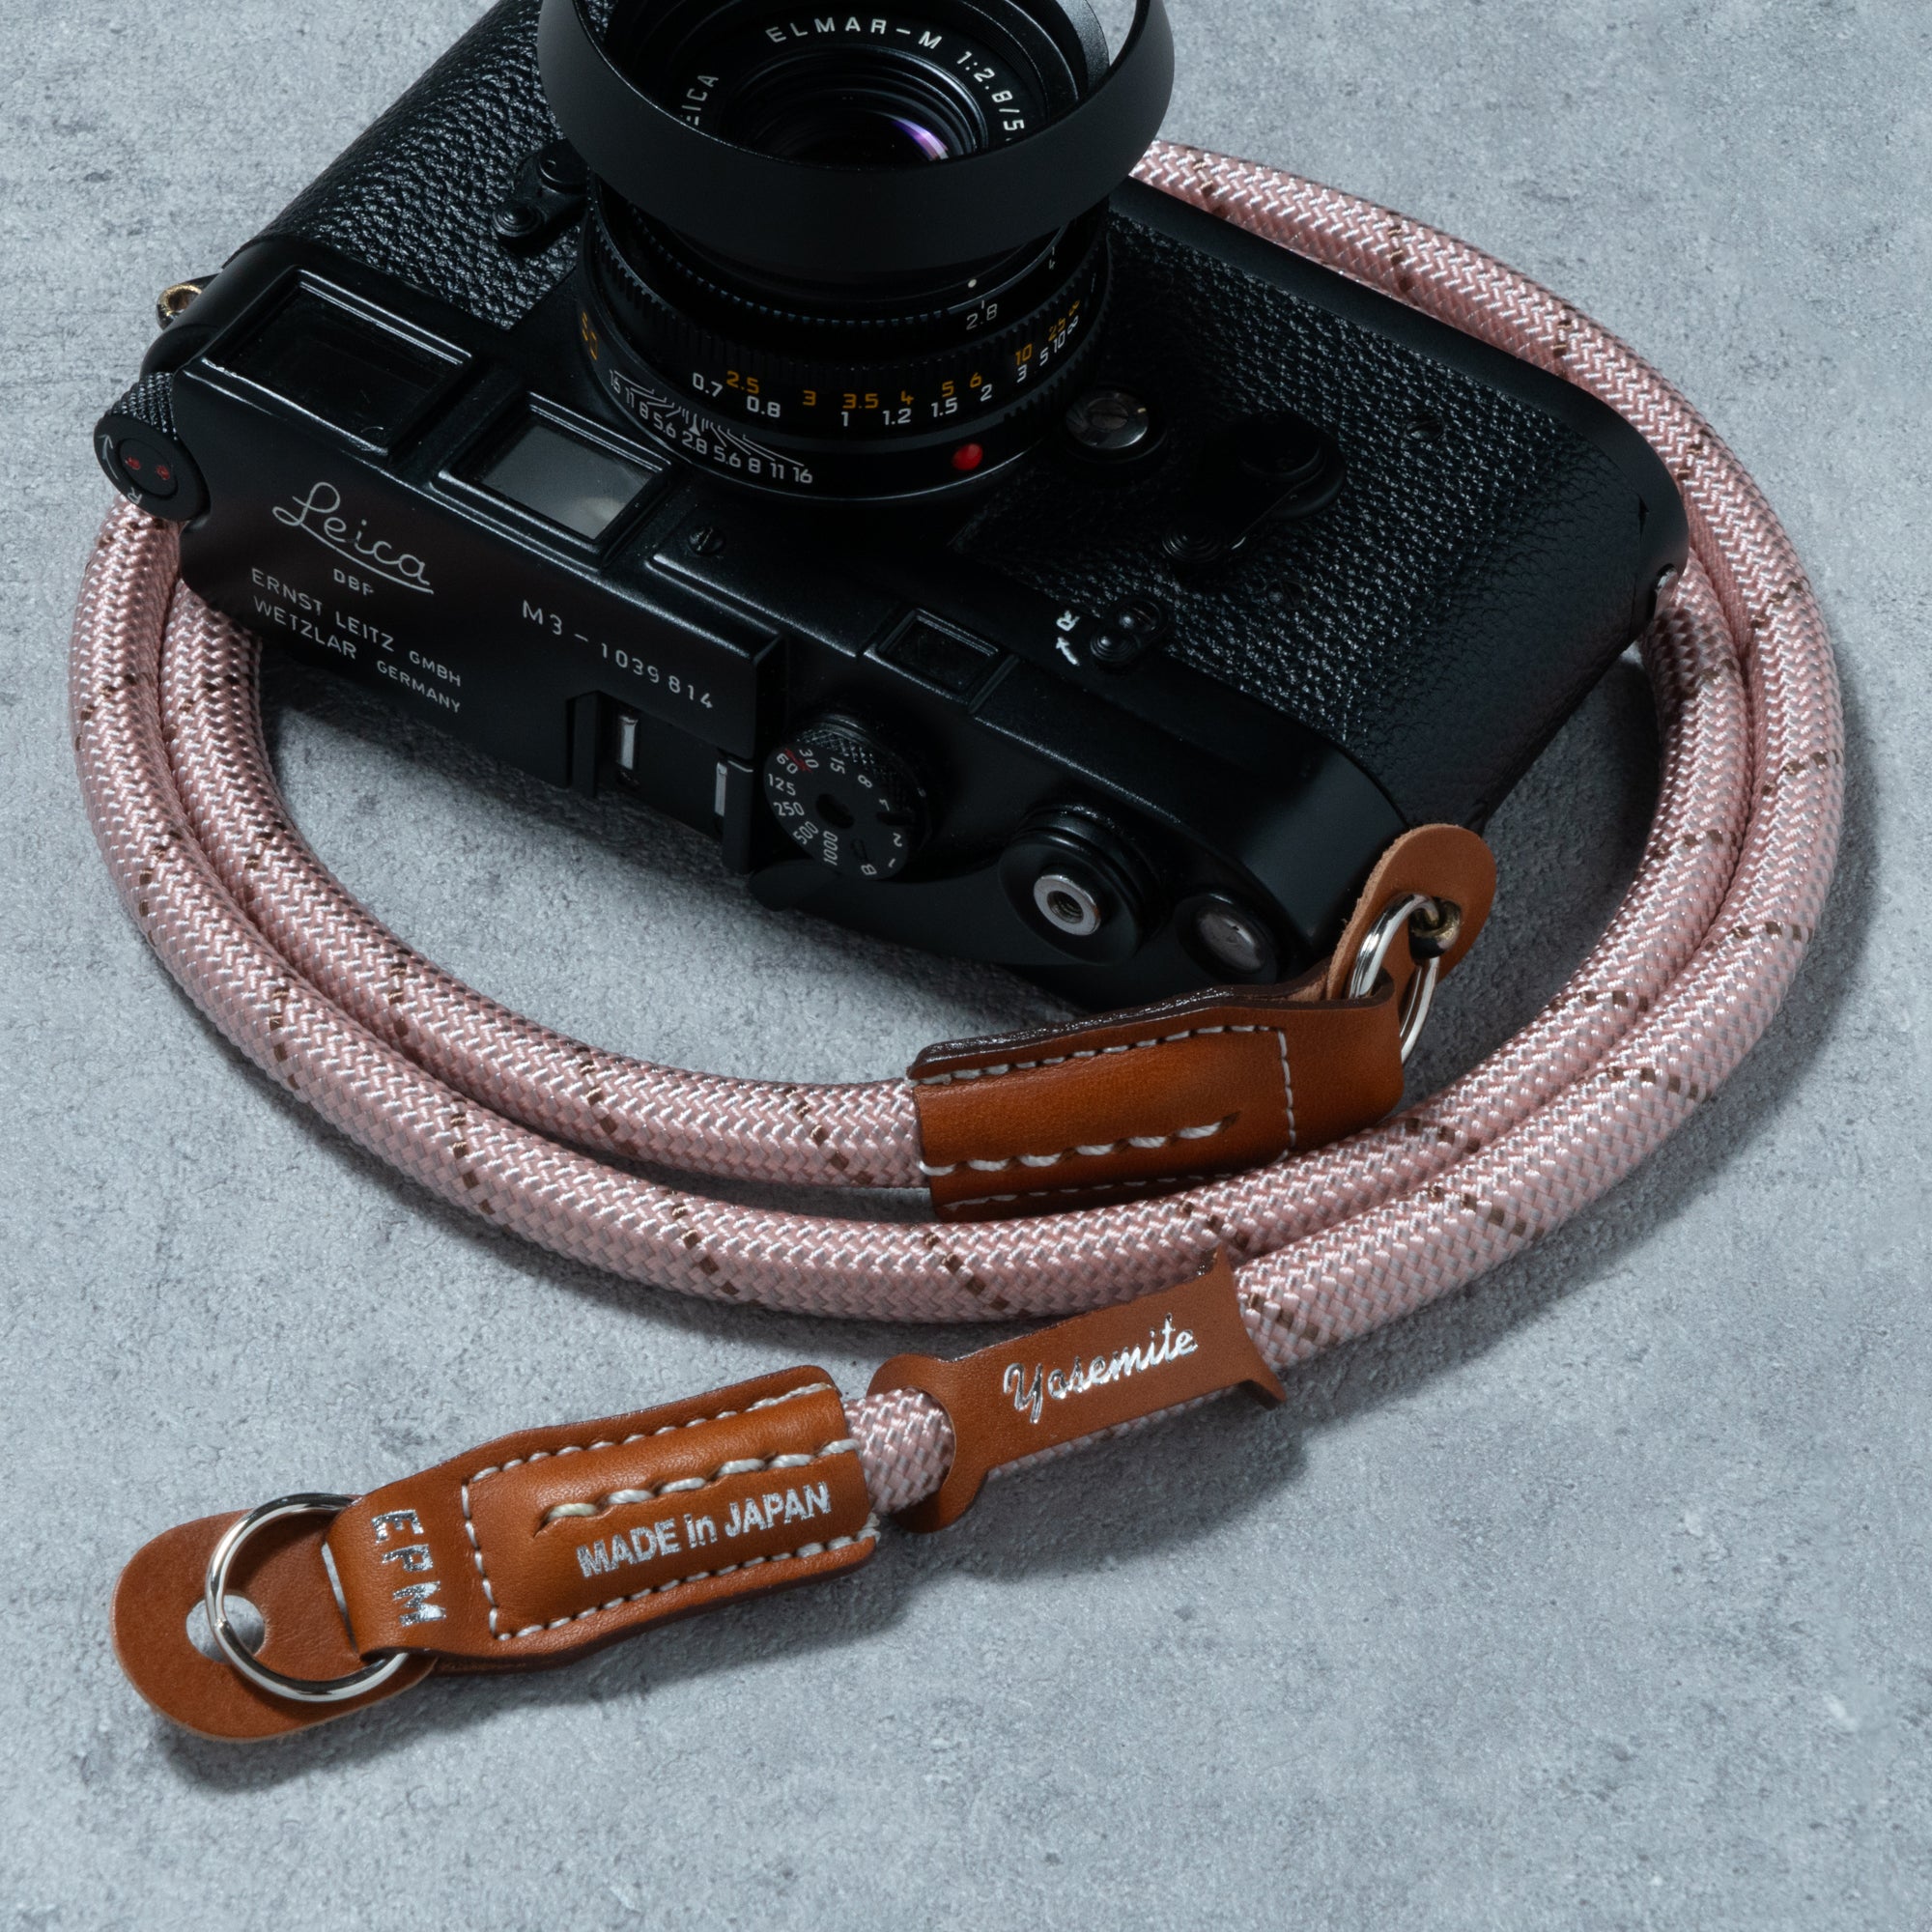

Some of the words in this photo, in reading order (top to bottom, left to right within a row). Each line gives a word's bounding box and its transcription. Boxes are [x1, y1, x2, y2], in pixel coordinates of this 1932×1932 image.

[764, 15, 943, 50] ELMAR-M
[956, 50, 1026, 143] 1:2.8/5
[966, 302, 998, 331] 2.8
[691, 372, 724, 398] 0.7
[746, 394, 781, 418] 0.8
[840, 411, 849, 427] 1
[882, 407, 912, 425] 1.2
[930, 396, 958, 418] 1.5
[979, 383, 993, 403] 2
[1016, 363, 1028, 384] 3
[1038, 346, 1049, 367] 5
[1053, 328, 1066, 354] 10
[726, 369, 760, 395] 2.5
[803, 389, 817, 408] 3
[841, 392, 880, 410] 3.5
[899, 389, 915, 407] 4
[941, 380, 955, 399] 5
[969, 371, 983, 389] 6
[1014, 342, 1034, 366] 10
[609, 368, 621, 394] 16
[639, 401, 650, 420] 8
[652, 410, 677, 440] 5.6
[681, 431, 708, 456] 2.8
[713, 443, 743, 469] 5.6
[747, 457, 762, 474] 8
[769, 460, 784, 480] 11
[792, 465, 813, 485] 16
[271, 481, 435, 595] Leica
[332, 568, 374, 596] DBF
[250, 567, 323, 616] ERNST
[335, 611, 395, 653] LEITZ
[409, 649, 462, 688] GMBH
[522, 599, 563, 637] M3
[253, 595, 357, 661] WETZLAR
[376, 659, 461, 714] GERMANY
[776, 752, 800, 775] 60
[799, 748, 820, 770] 30
[830, 756, 846, 775] 15
[768, 773, 797, 797] 125
[857, 774, 873, 789] 8
[773, 801, 805, 817] 250
[792, 821, 819, 846] 500
[822, 830, 839, 867] 1000
[893, 832, 903, 848] 2
[1003, 1312, 1199, 1425] Yosemite
[577, 1519, 681, 1578] MADE
[687, 1513, 718, 1547] in
[724, 1481, 832, 1538] JAPAN
[371, 1508, 448, 1628] EPM
